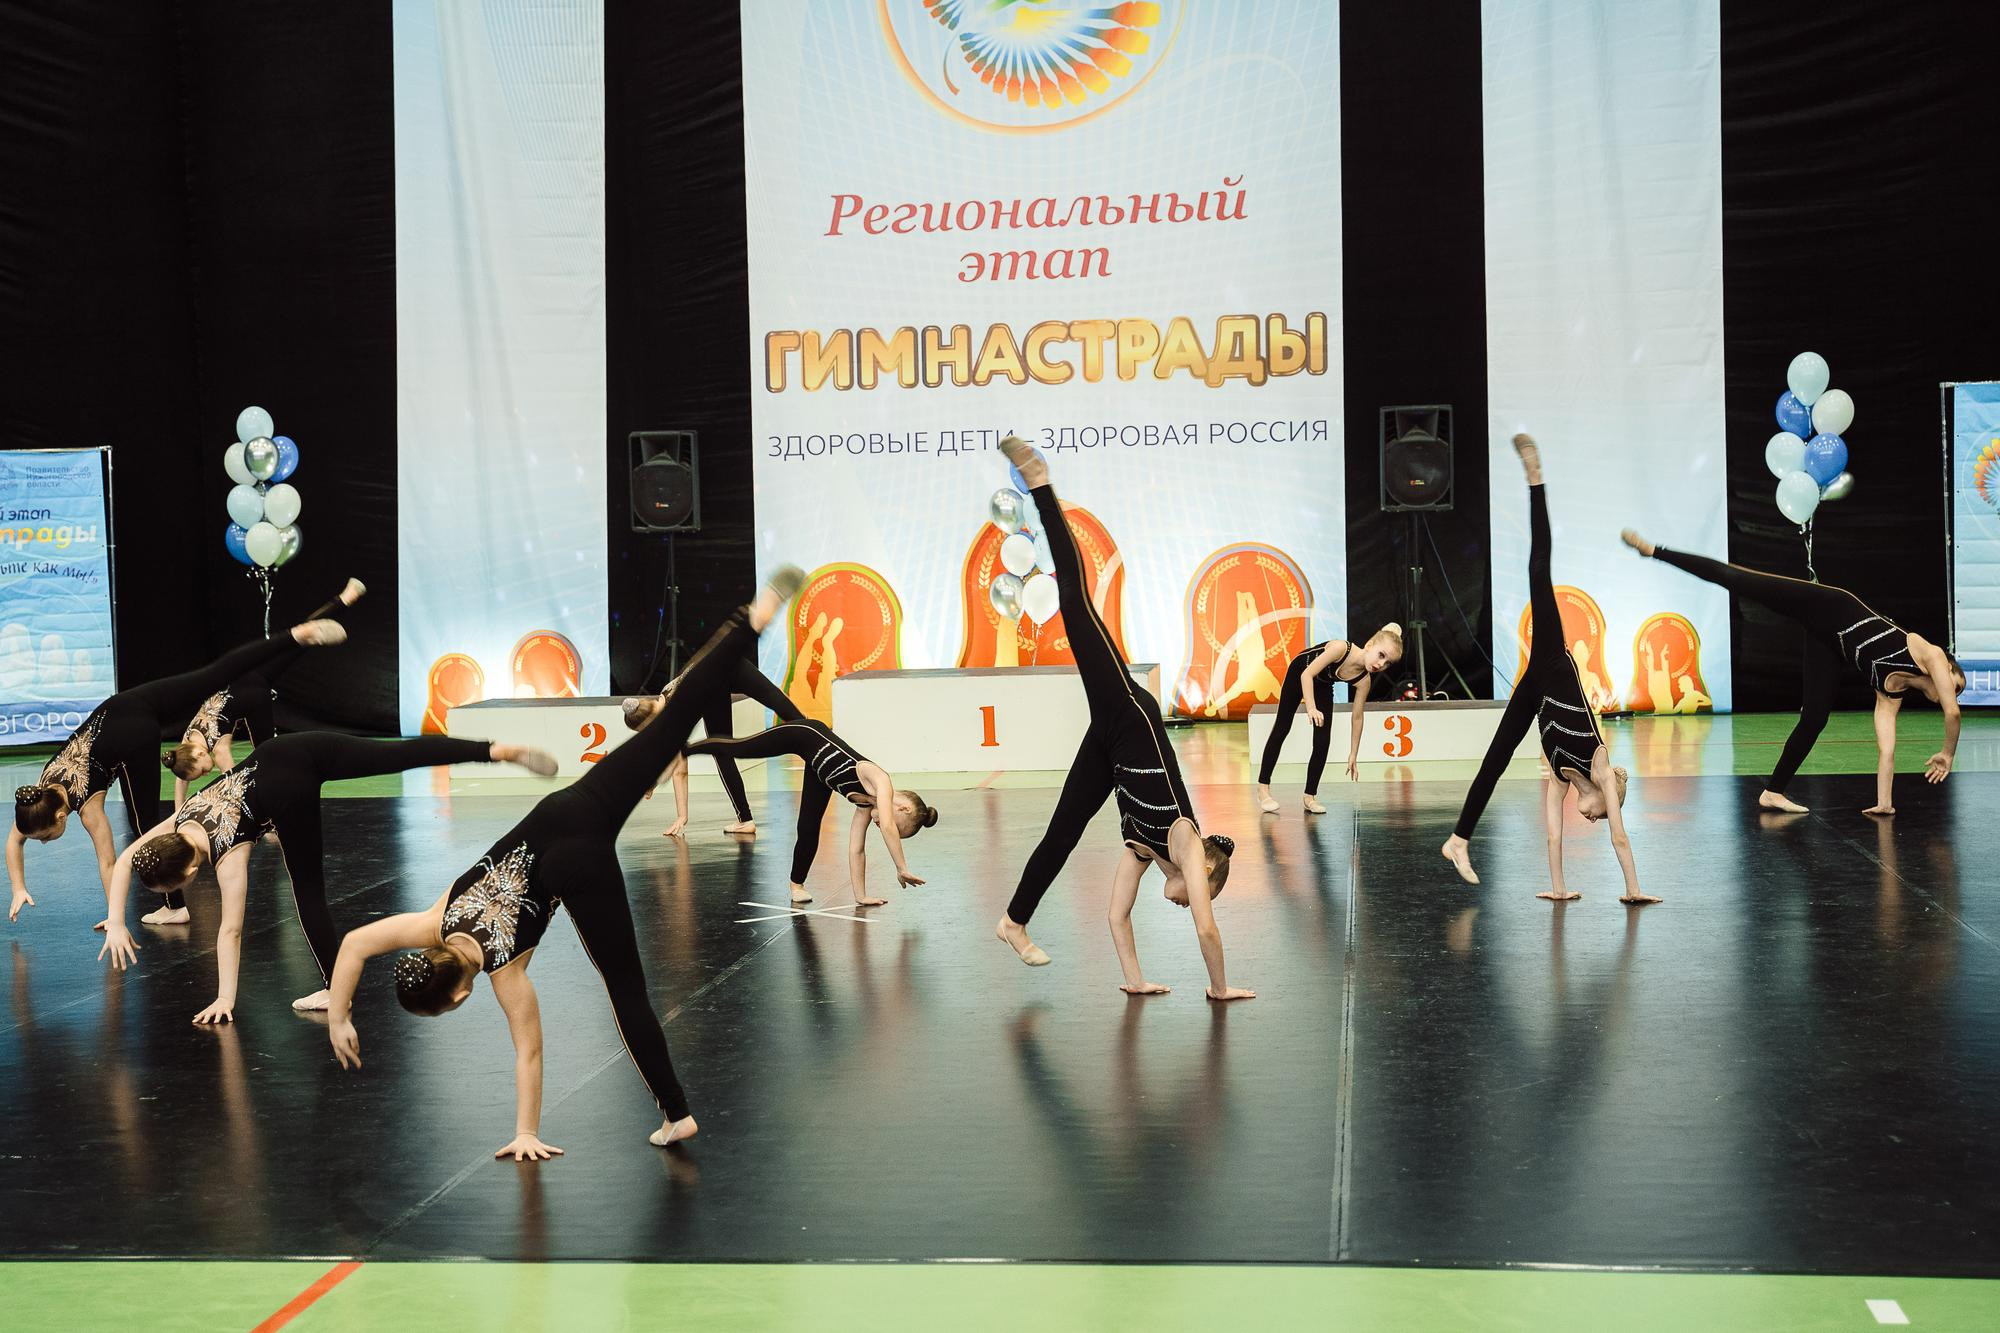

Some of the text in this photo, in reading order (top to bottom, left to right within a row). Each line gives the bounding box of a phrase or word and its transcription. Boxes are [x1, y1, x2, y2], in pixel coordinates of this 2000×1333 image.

[824, 173, 1248, 237] Региональный
[958, 246, 1112, 283] этап
[764, 311, 1328, 393] ГИМНАСТРАДЫ
[768, 432, 929, 462] ЗДОРОВЫЕ
[1040, 424, 1199, 453] ЗДОРОВАЯ
[1209, 419, 1328, 444] РОССИЯ
[8, 508, 51, 520] этап
[33, 562, 58, 575] как
[580, 722, 609, 764] 2
[979, 705, 1000, 747] 1
[1383, 714, 1414, 758] 3
